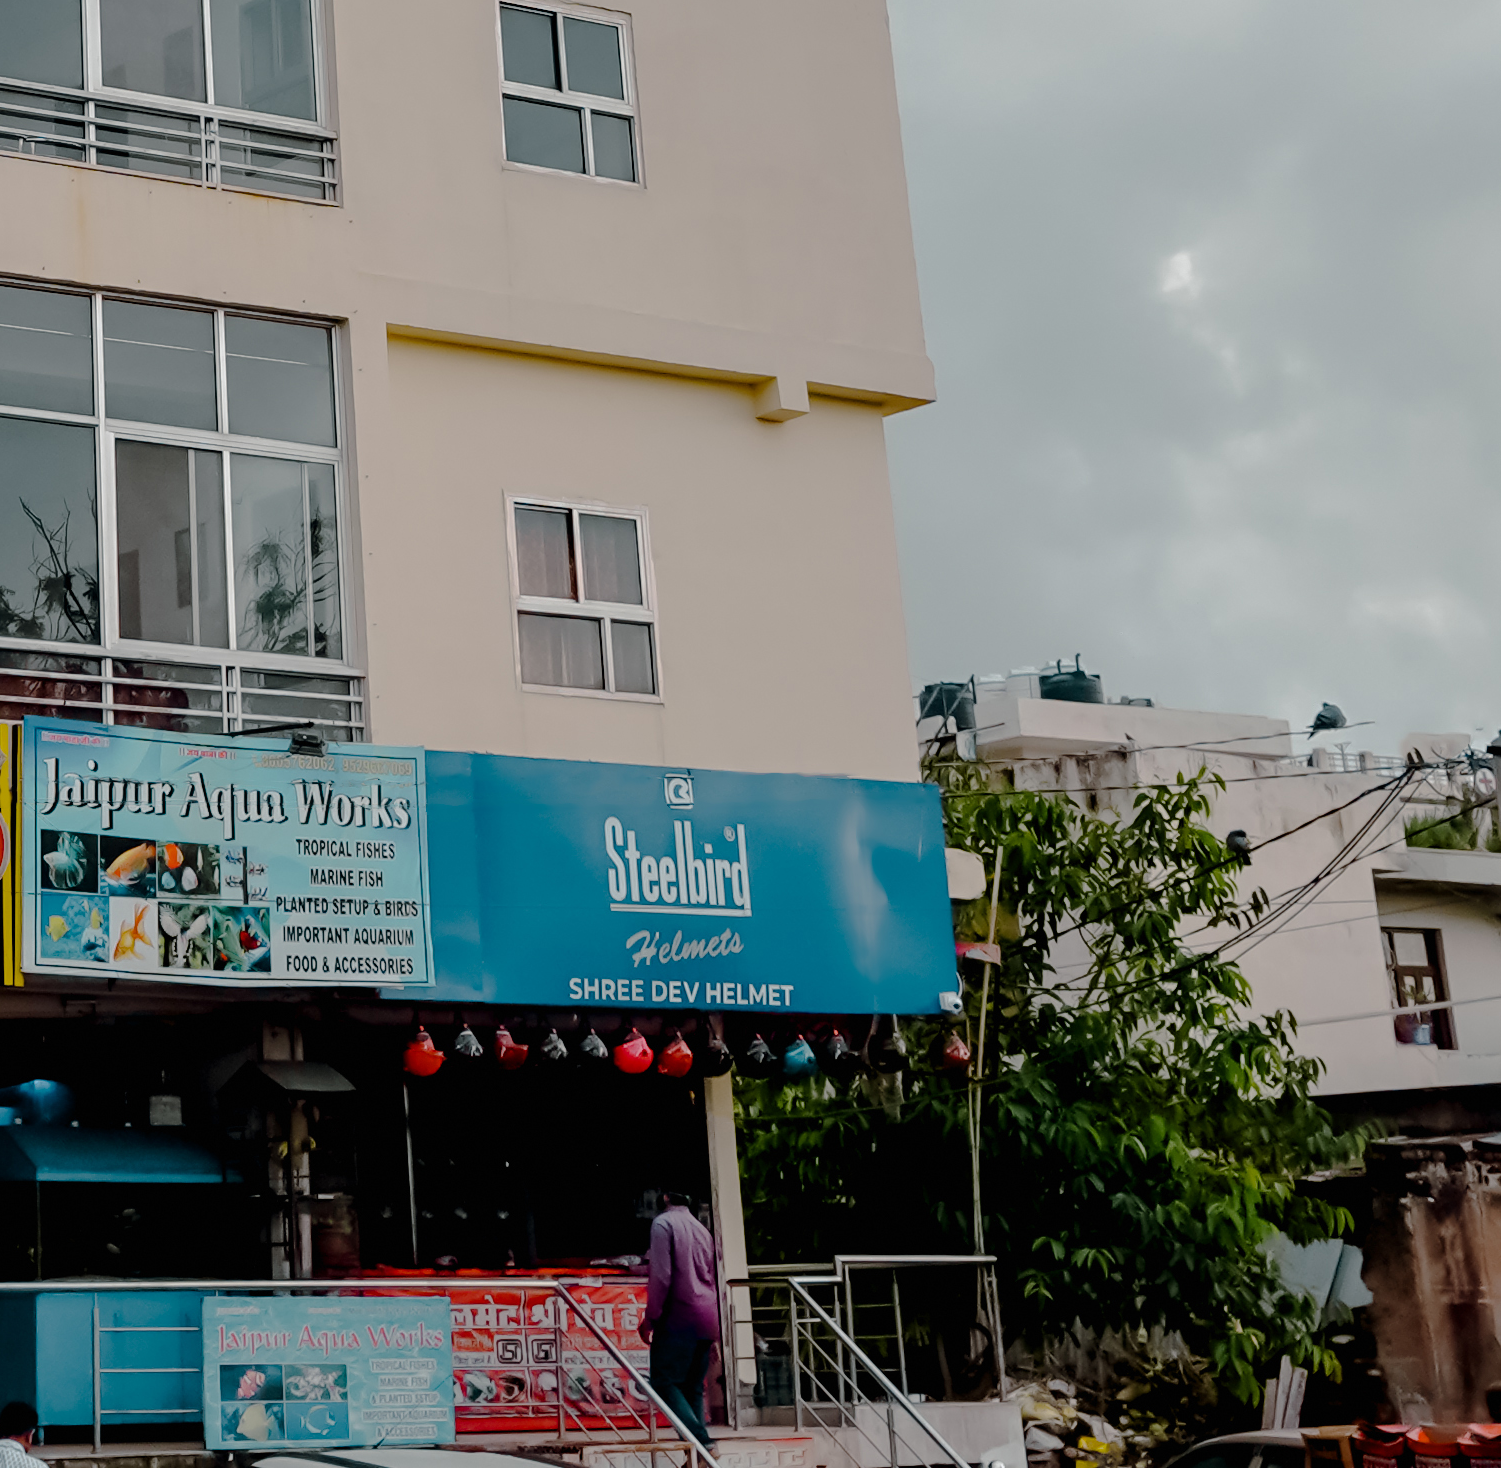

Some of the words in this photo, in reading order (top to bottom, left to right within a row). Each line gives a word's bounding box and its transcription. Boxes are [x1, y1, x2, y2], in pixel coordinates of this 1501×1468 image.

[40, 757, 175, 831] Jaipur
[179, 771, 289, 841] Aqua
[292, 778, 411, 829] Works
[295, 838, 352, 857] TROPICAL
[355, 841, 395, 859] FISHES
[310, 868, 354, 886] MARINE
[358, 870, 383, 887] FISH
[604, 815, 752, 917] Steelbird
[276, 896, 329, 914] PLANTED
[332, 898, 369, 915] SETUP
[373, 899, 381, 916] &
[385, 901, 418, 917] BIRDS
[282, 926, 349, 944] IMPORTANT
[353, 928, 414, 946] AQUARIUM
[625, 928, 745, 968] Helmets
[286, 955, 318, 972] FOOD
[322, 956, 330, 973] &
[334, 957, 414, 975] ACCESSORIES
[569, 978, 644, 1002] SHREE
[651, 980, 700, 1004] DEV
[705, 982, 794, 1007] HELMET
[217, 1324, 292, 1356] Jaipur
[298, 1324, 361, 1356] Aqua
[365, 1321, 445, 1349] Works
